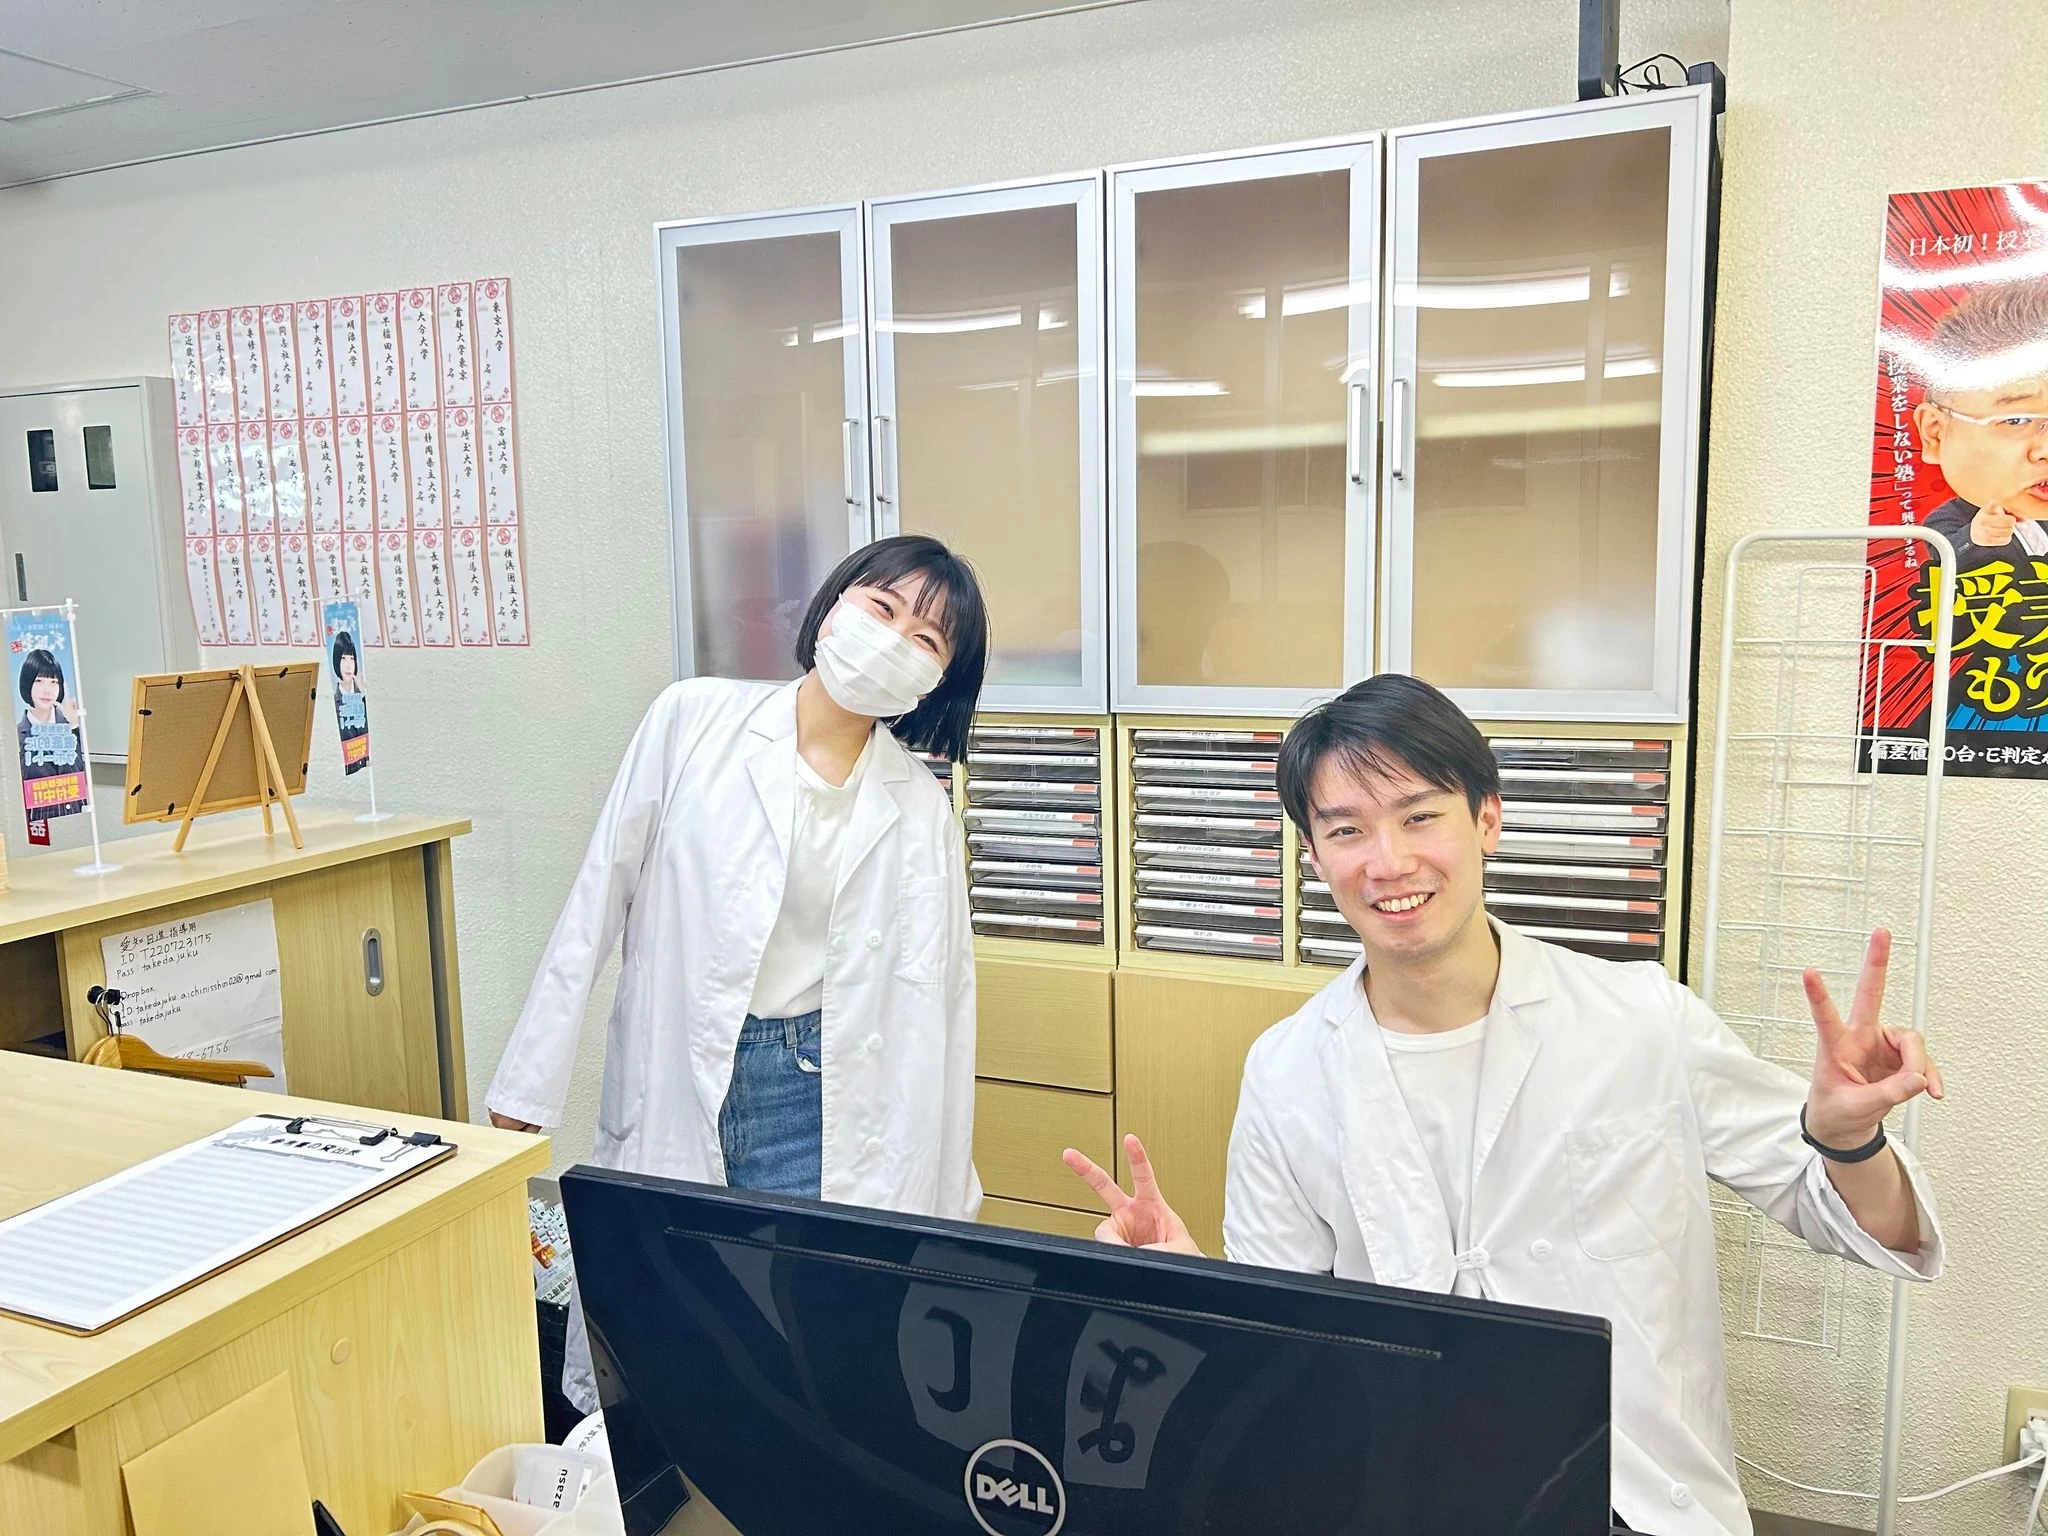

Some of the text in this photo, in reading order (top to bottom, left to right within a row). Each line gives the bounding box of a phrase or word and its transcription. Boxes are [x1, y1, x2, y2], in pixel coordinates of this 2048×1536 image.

[312, 323, 324, 369] 中央大学
[346, 320, 358, 367] 明治大学
[382, 316, 394, 376] 早稲田大学
[417, 311, 428, 360] 大分大学
[454, 306, 468, 381] 首都大学東京
[493, 302, 504, 352] 東京大学
[215, 332, 226, 378] 日本大学
[246, 328, 258, 374] 専修大学
[279, 326, 291, 384] 同志社大学
[320, 440, 332, 486] 法政大学
[354, 438, 368, 508] 青山学院大学
[388, 436, 399, 483] 上智大学
[424, 432, 436, 504] 静岡県立大学
[461, 430, 472, 478] 埼玉大学
[498, 426, 508, 474] 宮崎大学
[264, 554, 276, 598] 成城大学
[296, 556, 309, 612] 立命館大学
[328, 554, 341, 604] 学習院大
[360, 554, 371, 599] 立教大学
[394, 554, 408, 622] 明治学院大学
[430, 551, 444, 621] 長野県立大学
[466, 550, 480, 597] 群馬大学
[504, 549, 519, 620] 横浜国立大学
[120, 922, 198, 954] 愛知日進 指導用
[142, 949, 199, 972] takedajuku
[174, 1039, 230, 1060] 8-6756
[552, 1469, 568, 1508] azasu
[976, 1473, 1054, 1515] DELL
